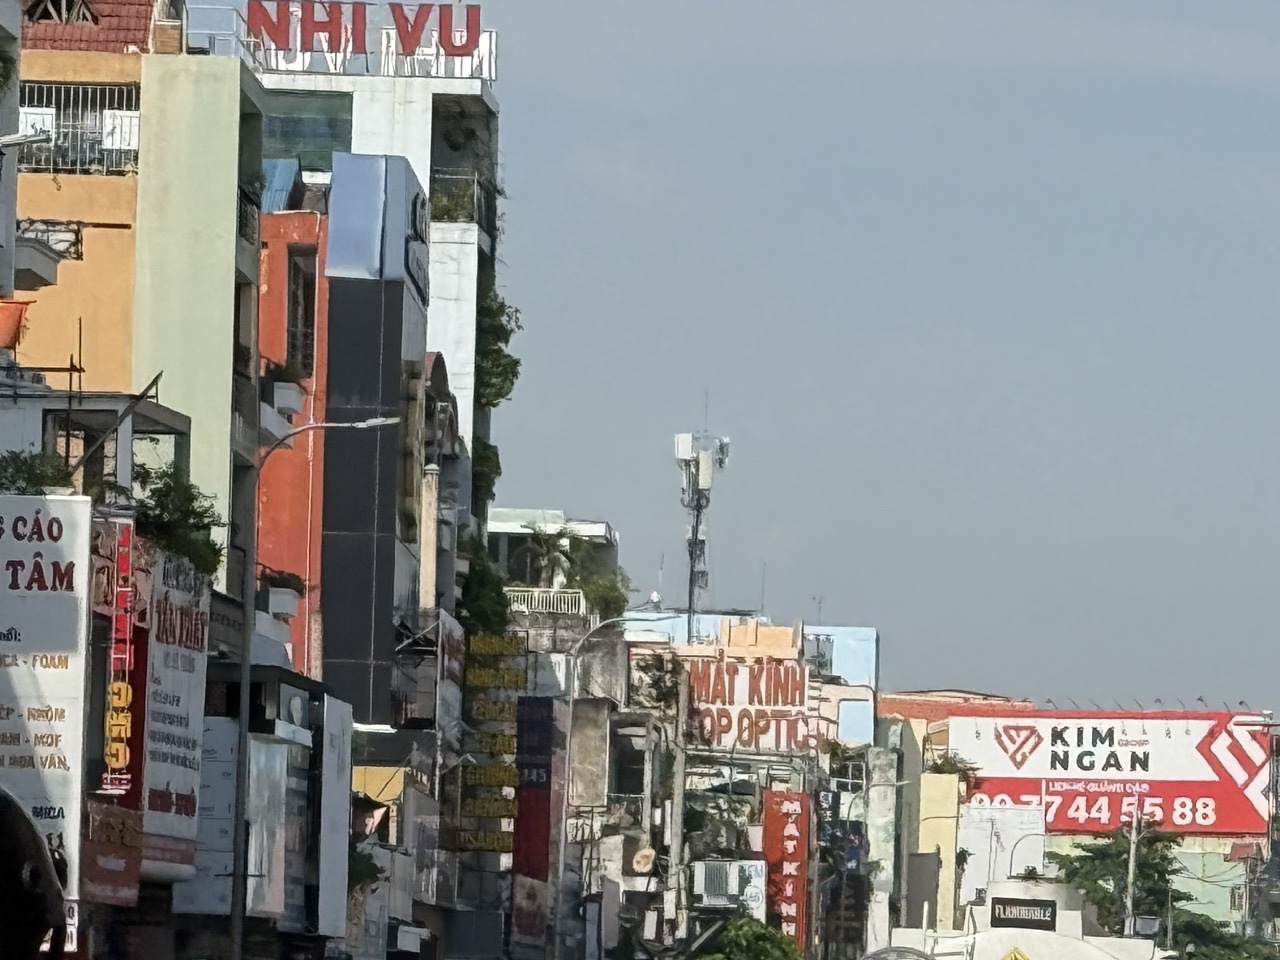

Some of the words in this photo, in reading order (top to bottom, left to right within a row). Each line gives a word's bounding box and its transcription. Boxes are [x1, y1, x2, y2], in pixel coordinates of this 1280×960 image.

[247, 0, 367, 54] NHI
[5, 551, 76, 592] TÂM
[1050, 726, 1115, 748] KIM
[1050, 750, 1150, 772] NGAN
[1172, 796, 1217, 826] 88
